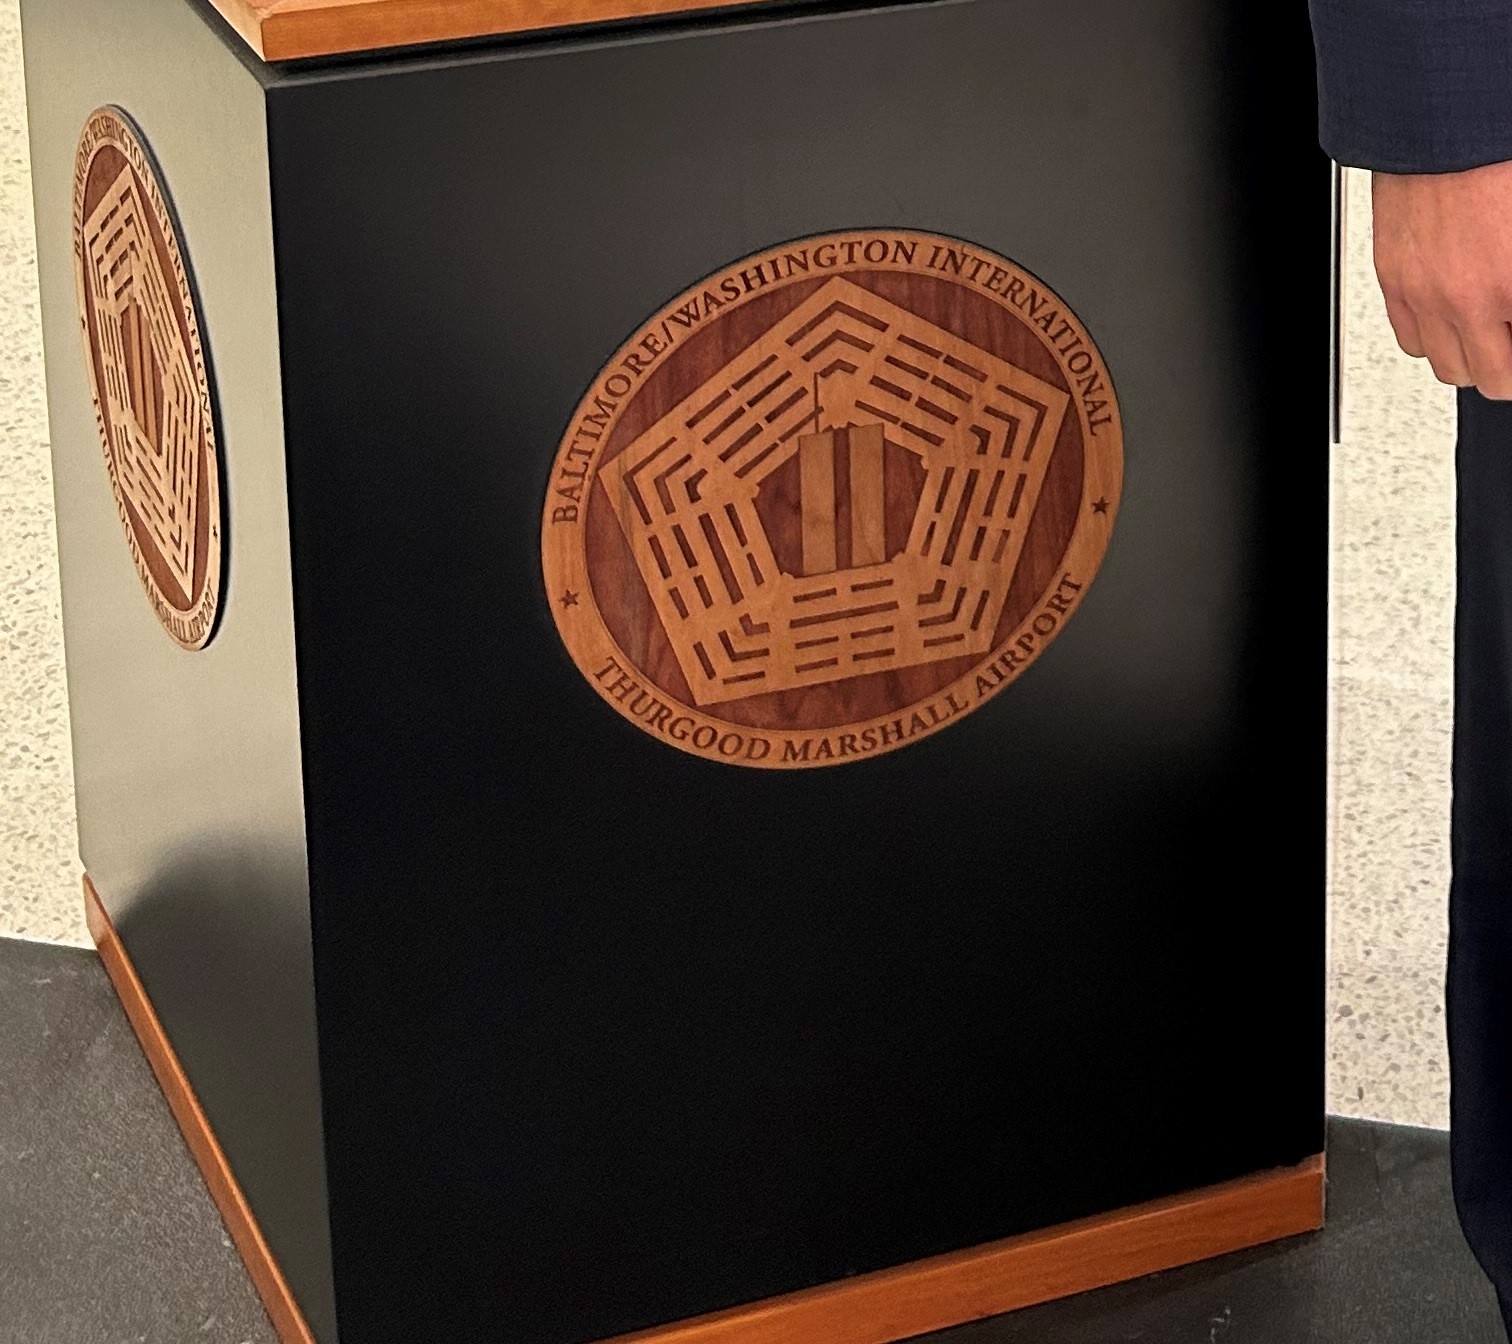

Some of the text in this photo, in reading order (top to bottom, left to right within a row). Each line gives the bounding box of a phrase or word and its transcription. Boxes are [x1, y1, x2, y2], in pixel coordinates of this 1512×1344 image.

[552, 238, 1112, 526] BALTIMORE/WASHINGTON INTERNATIONAL
[593, 572, 1083, 763] THURGOOD MARSHALL AIRPORT
